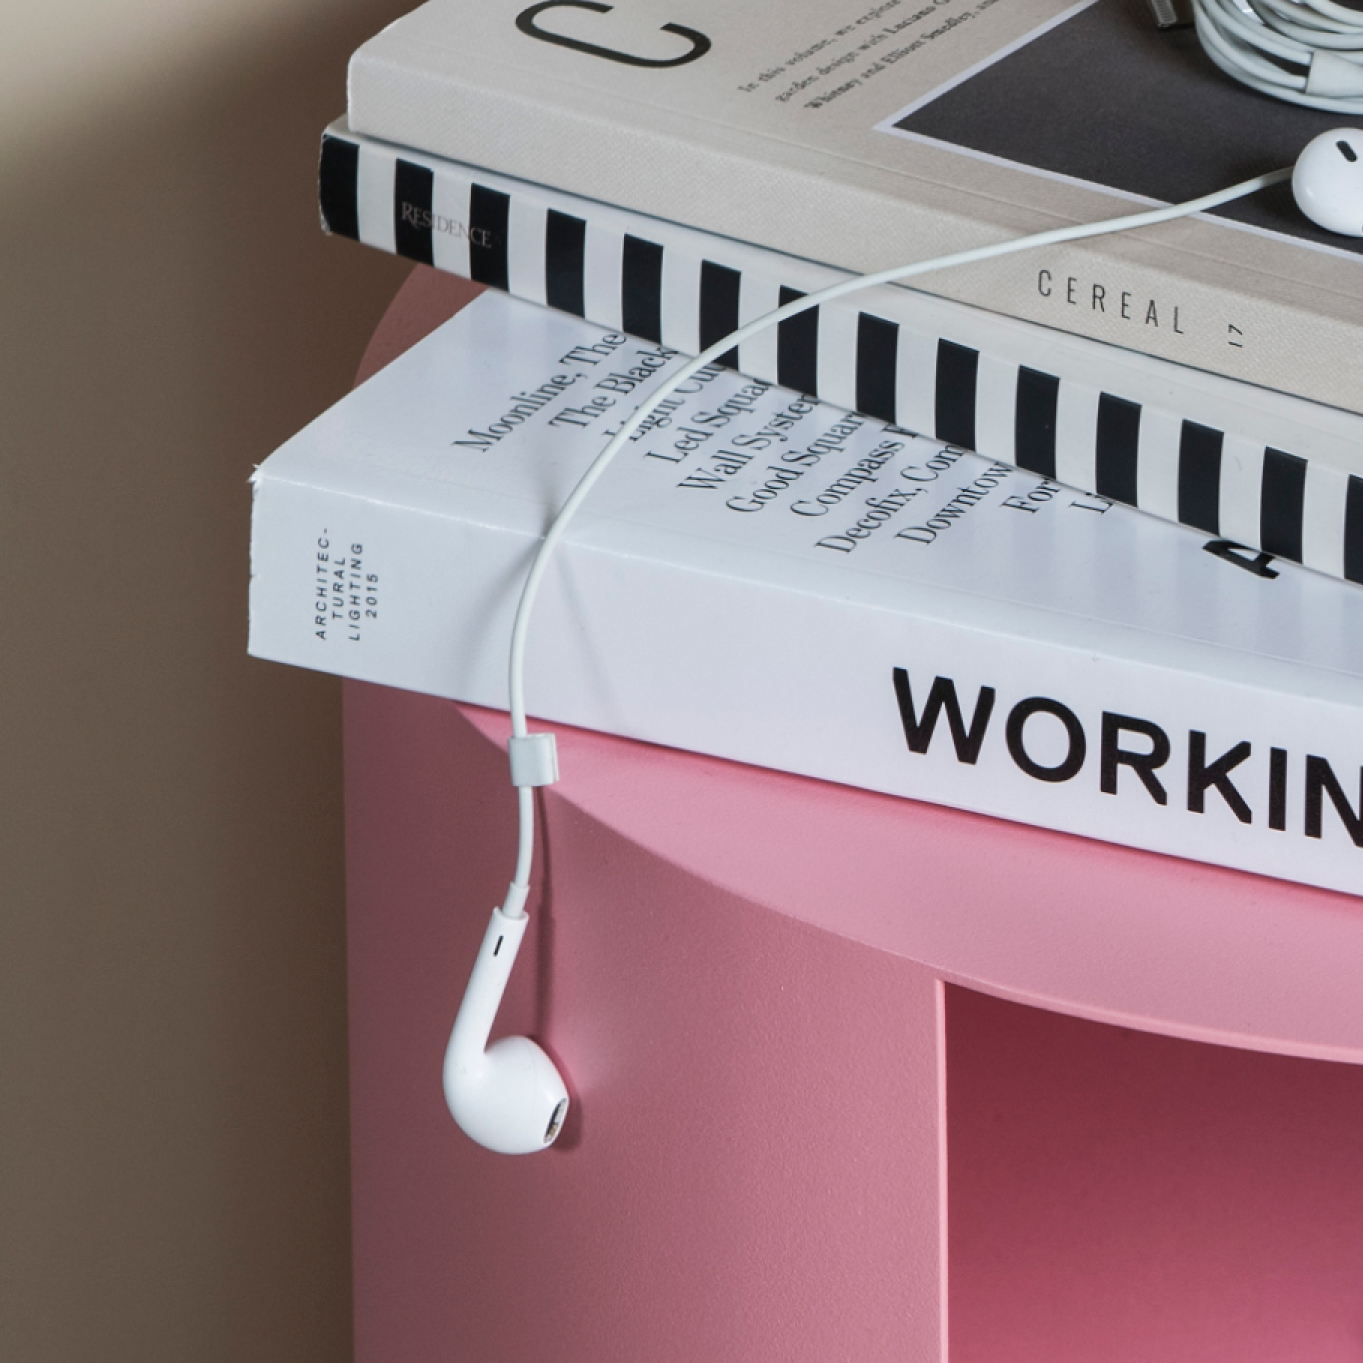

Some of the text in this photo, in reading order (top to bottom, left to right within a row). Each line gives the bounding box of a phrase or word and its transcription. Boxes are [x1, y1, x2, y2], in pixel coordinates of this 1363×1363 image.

[401, 201, 492, 249] RESIDENCE
[1038, 269, 1184, 334] CEREAL
[452, 332, 627, 453] Moonline, The
[548, 346, 679, 428] The Black
[645, 426, 714, 463] Led
[677, 449, 754, 489] Wall
[726, 465, 804, 513] Good
[789, 440, 905, 517] Compass
[814, 485, 929, 554] Decofix,
[315, 527, 330, 641] ARCHITEC-
[332, 557, 346, 620] TURAL
[348, 543, 363, 641] LIGHTING
[365, 573, 379, 619] 2015
